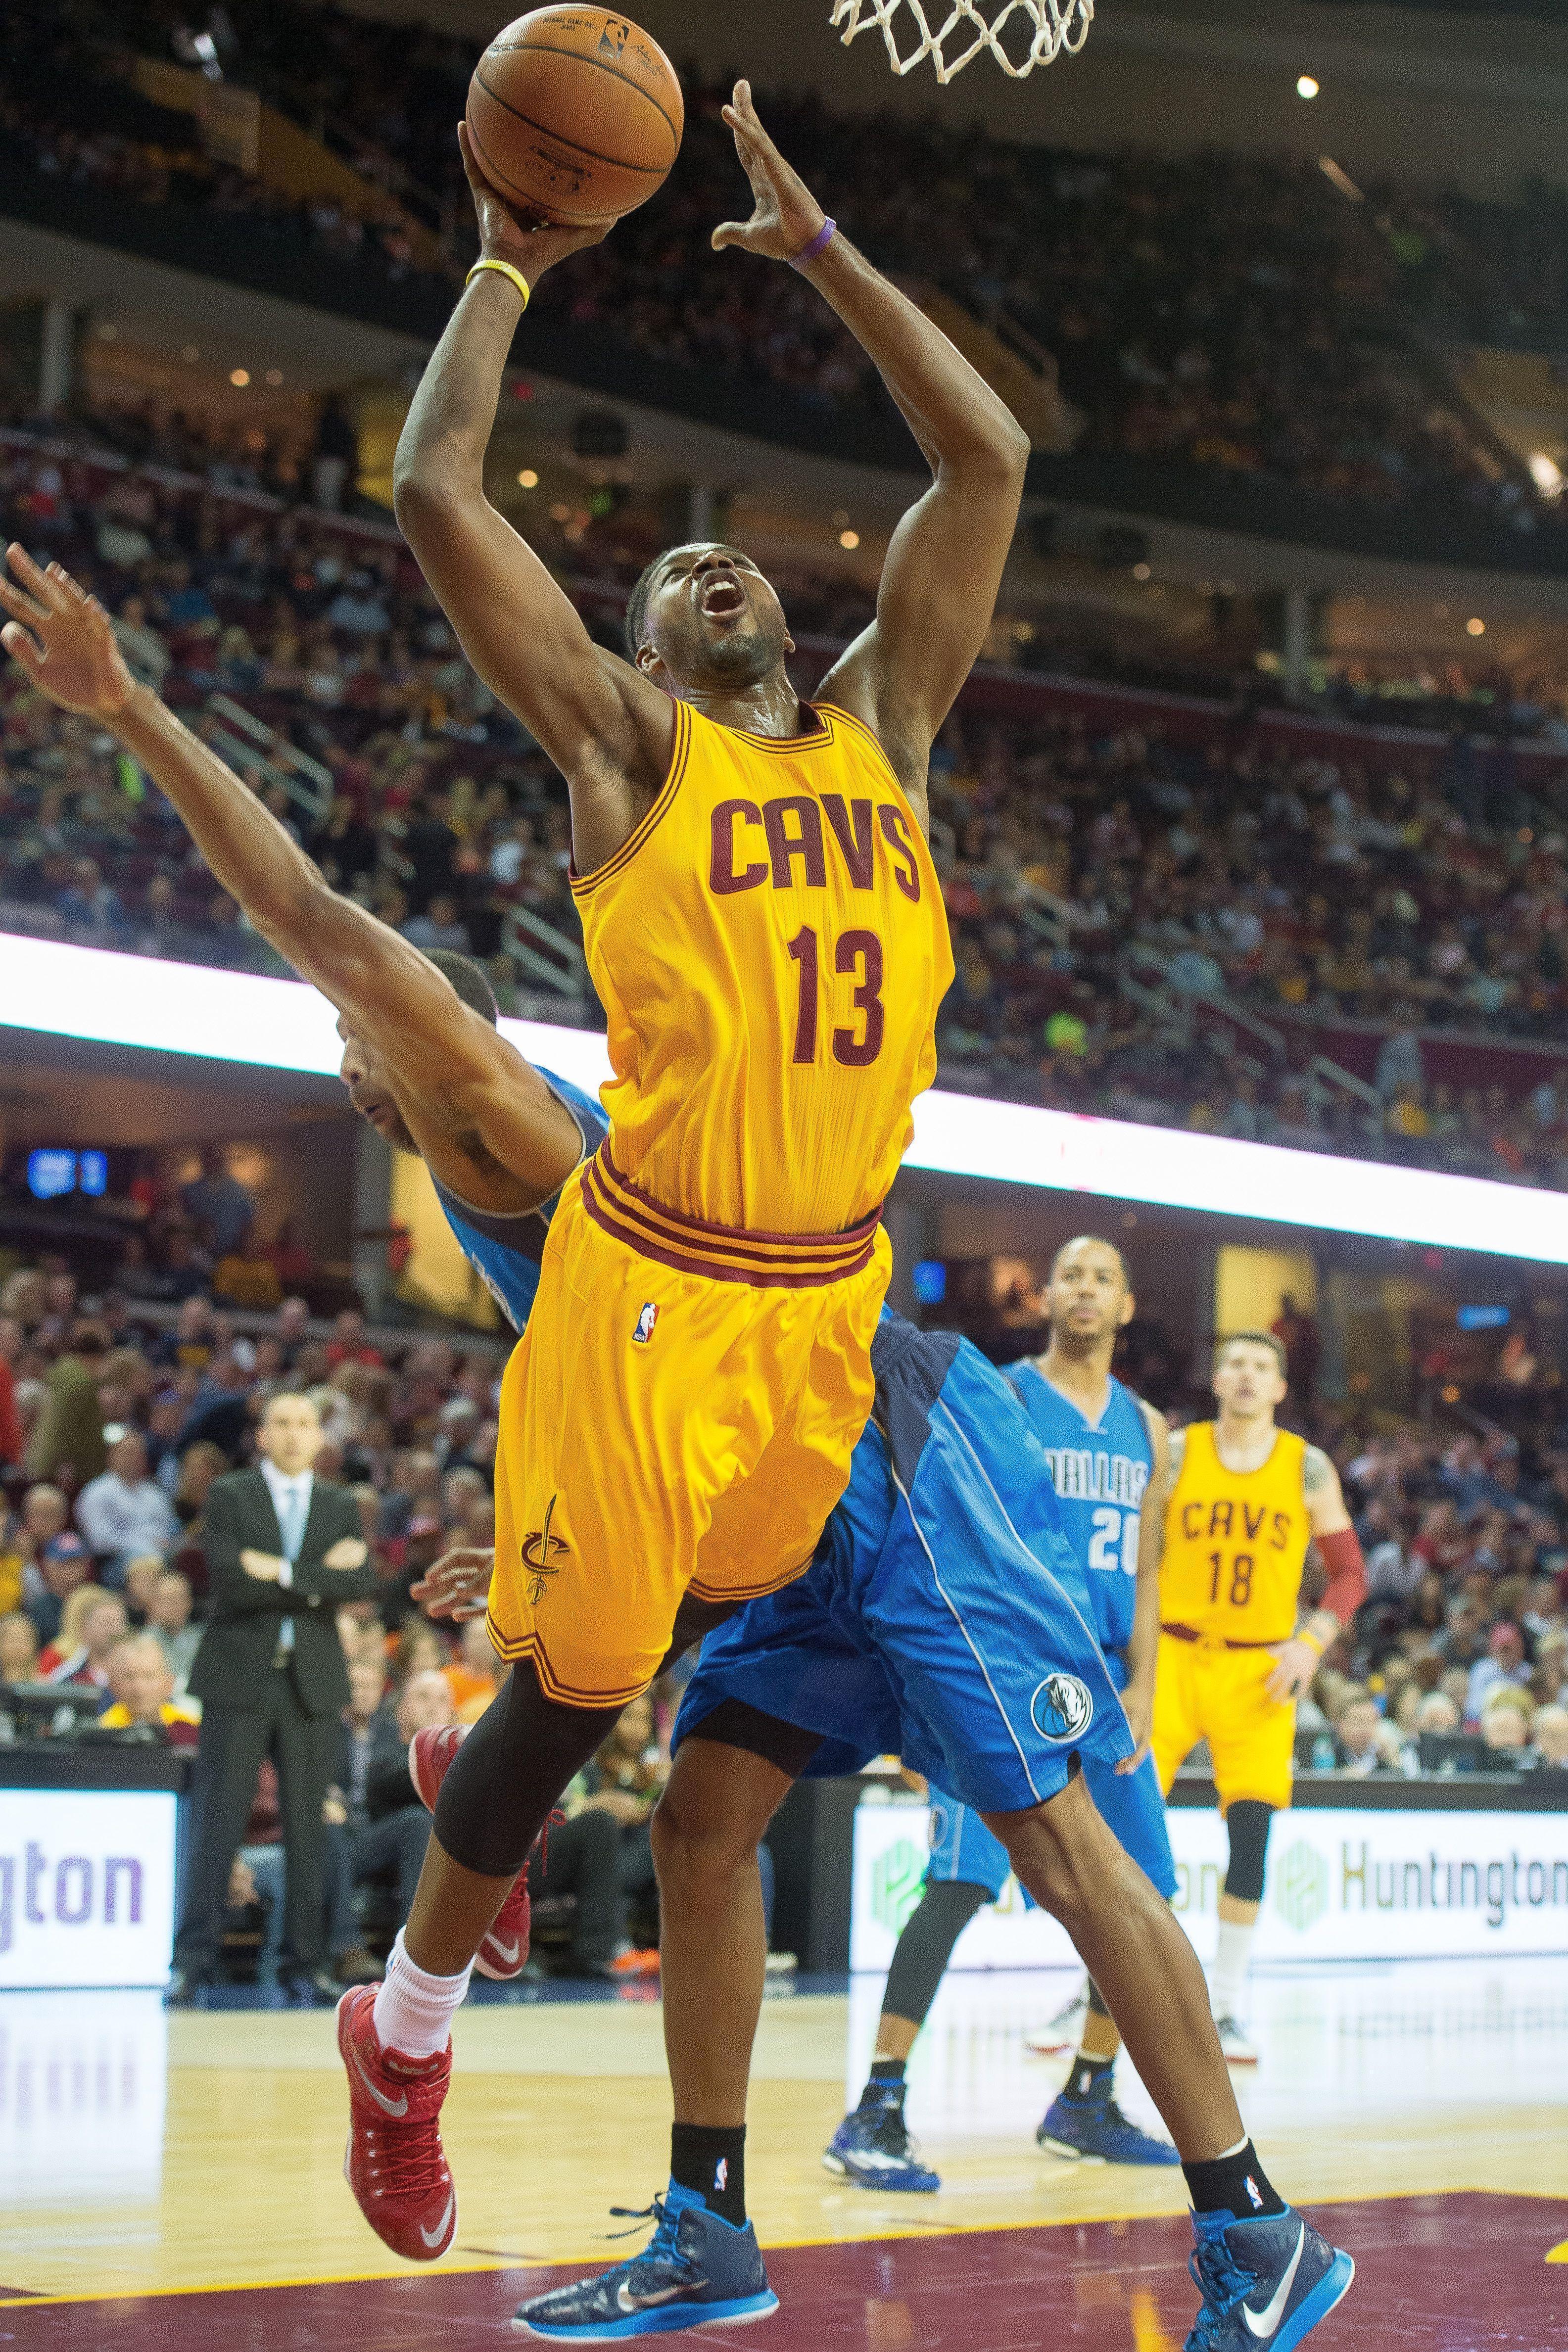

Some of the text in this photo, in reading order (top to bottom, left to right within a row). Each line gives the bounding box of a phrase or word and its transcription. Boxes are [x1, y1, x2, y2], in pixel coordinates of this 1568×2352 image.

[709, 794, 921, 903] CAVS
[787, 925, 884, 1066] 13
[1182, 1500, 1292, 1551] CAVS
[1207, 1551, 1255, 1607] 18
[1342, 1840, 1568, 1928] Huntington
